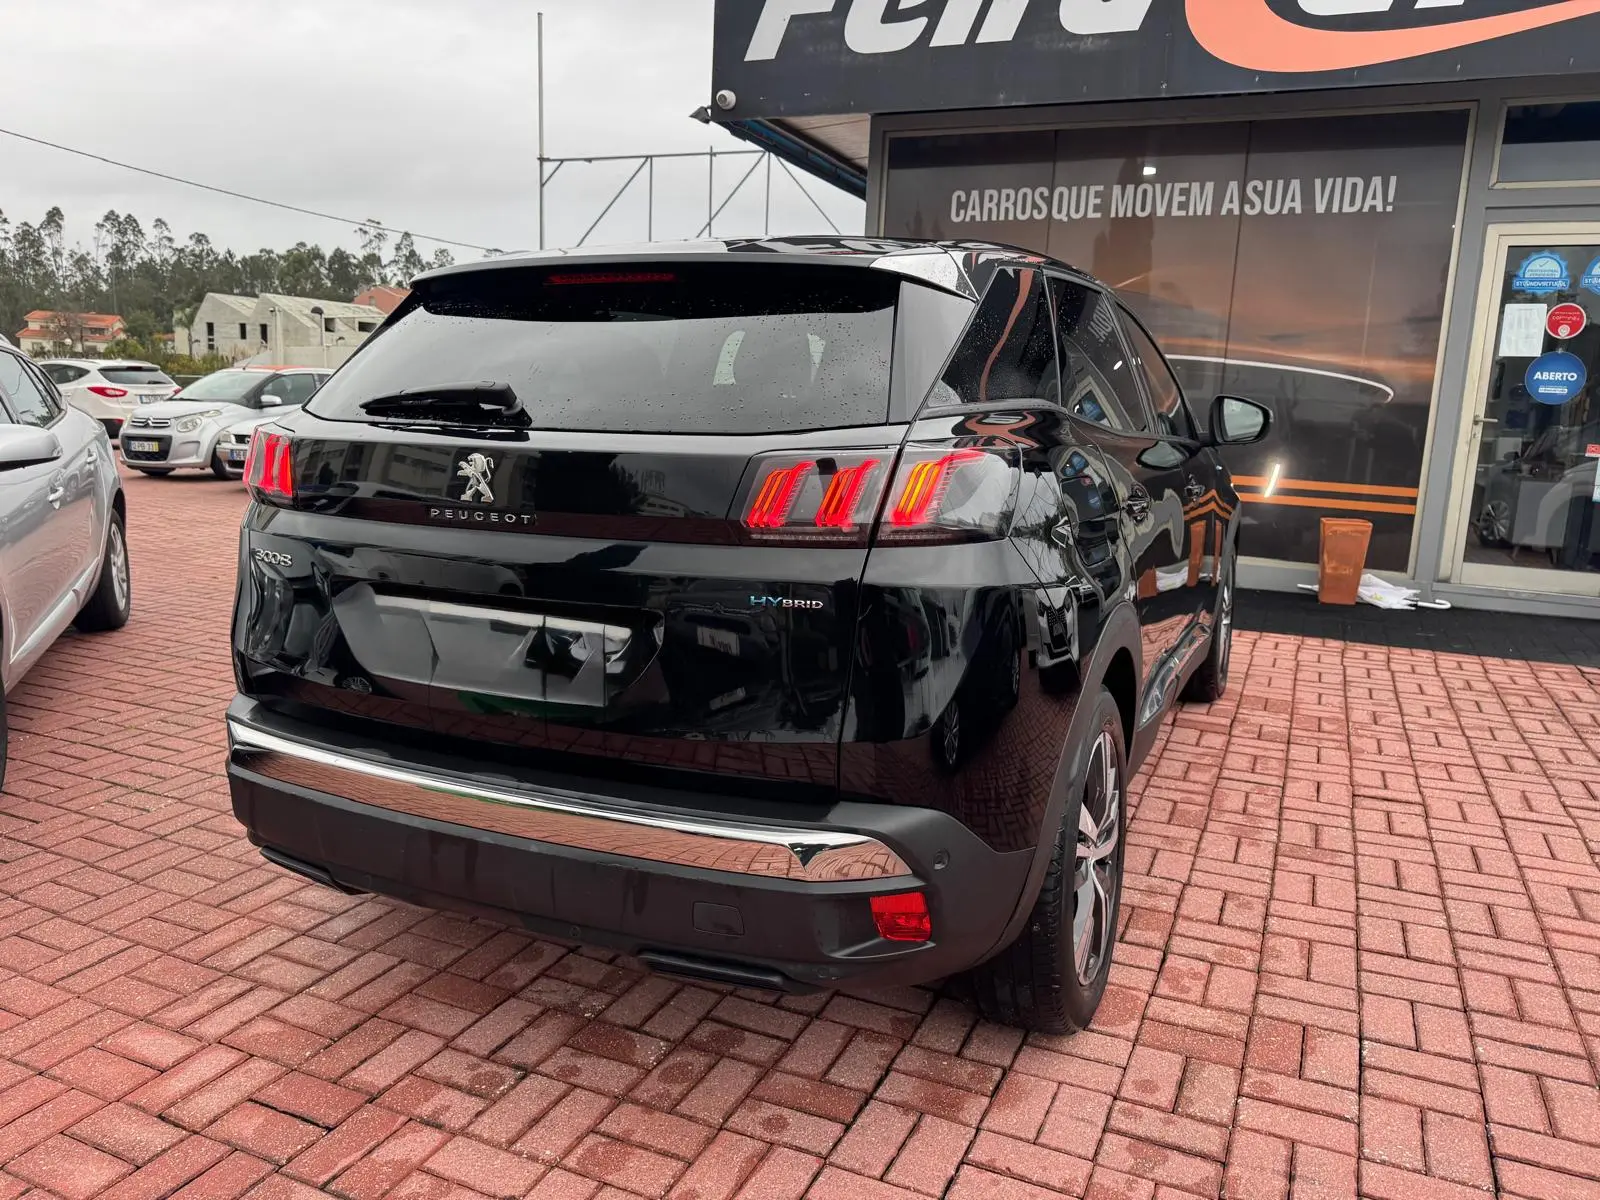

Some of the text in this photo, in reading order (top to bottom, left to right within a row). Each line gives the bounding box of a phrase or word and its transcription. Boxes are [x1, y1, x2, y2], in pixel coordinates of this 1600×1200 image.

[951, 175, 1397, 223] CARROS QUE MOVEM A SUA VIDA!
[1533, 371, 1578, 381] ABERTO
[430, 508, 531, 525] PEUGEOT
[255, 548, 292, 567] 3008
[750, 595, 824, 609] HYBRID
